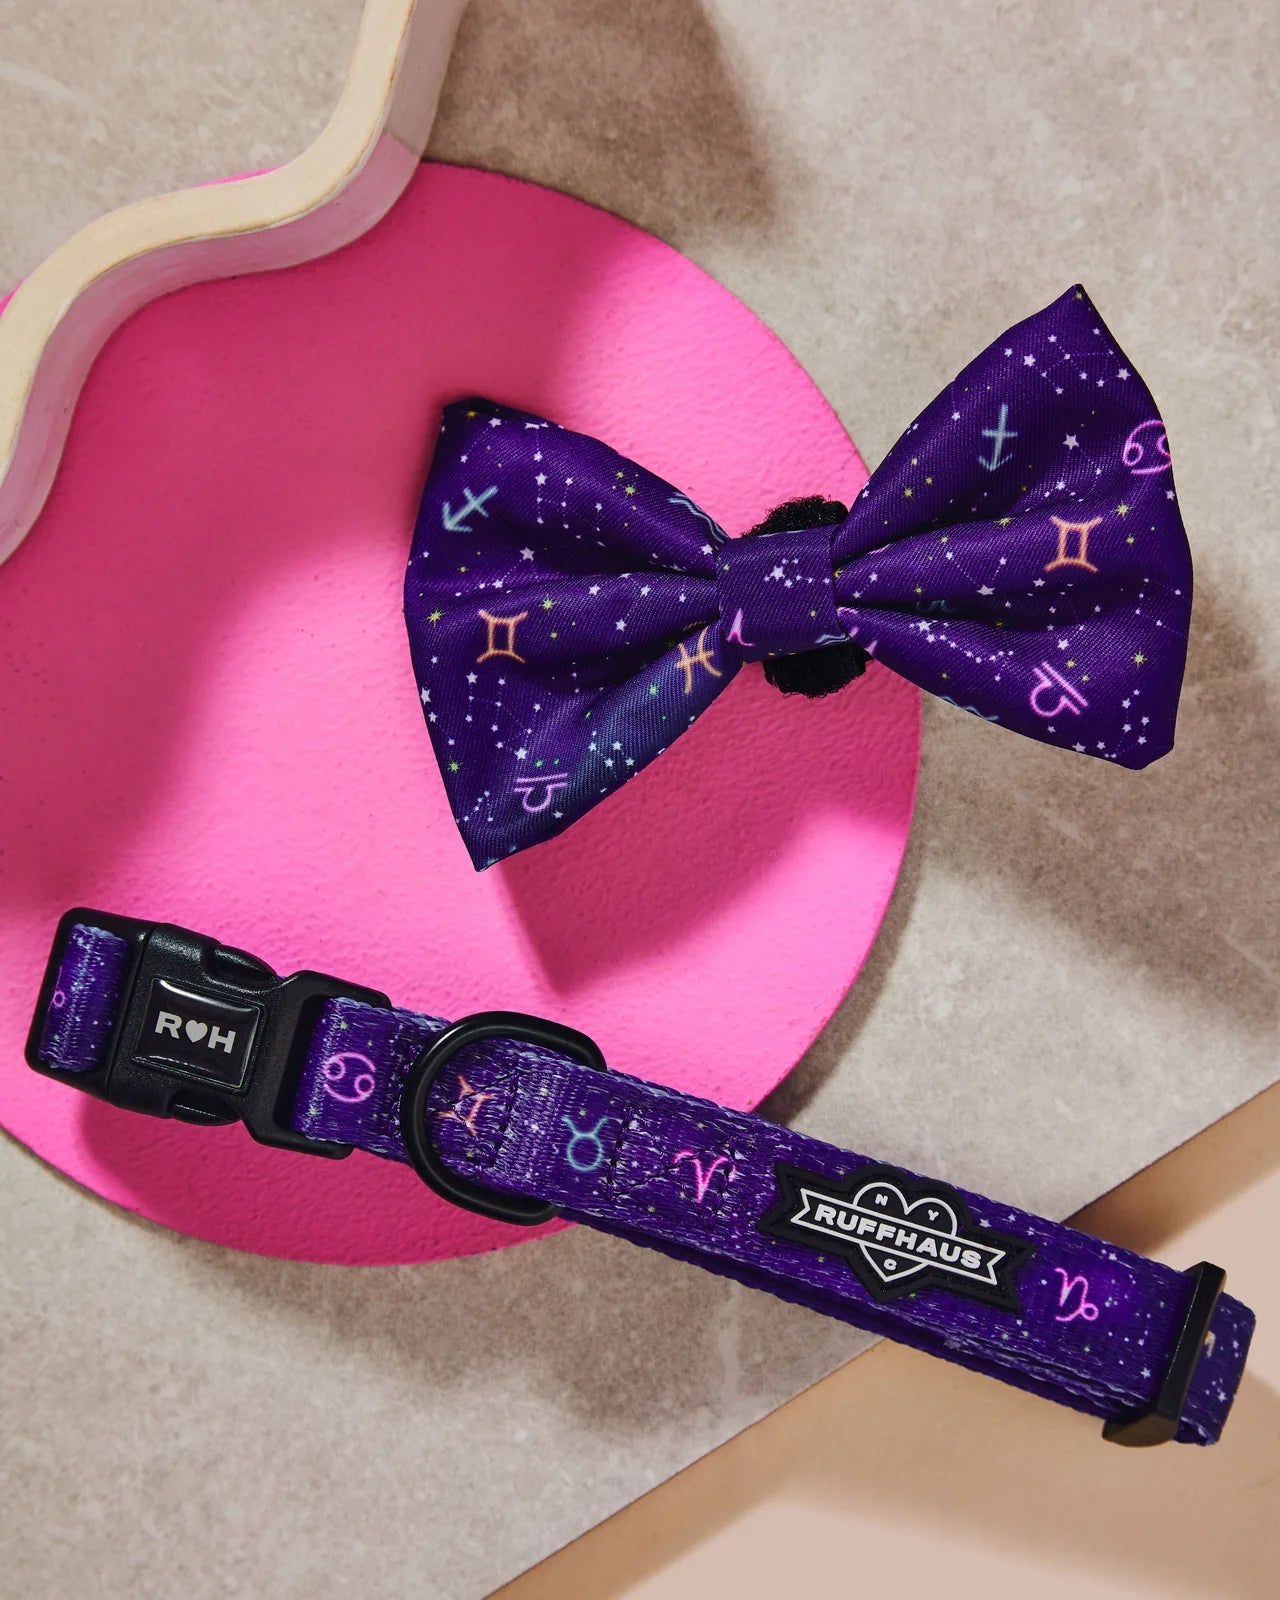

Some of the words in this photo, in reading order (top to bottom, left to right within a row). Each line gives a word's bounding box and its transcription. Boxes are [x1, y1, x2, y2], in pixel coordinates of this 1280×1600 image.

[874, 1193, 888, 1206] N
[927, 1209, 939, 1221] Y
[814, 1203, 982, 1270] RUFFHAUS
